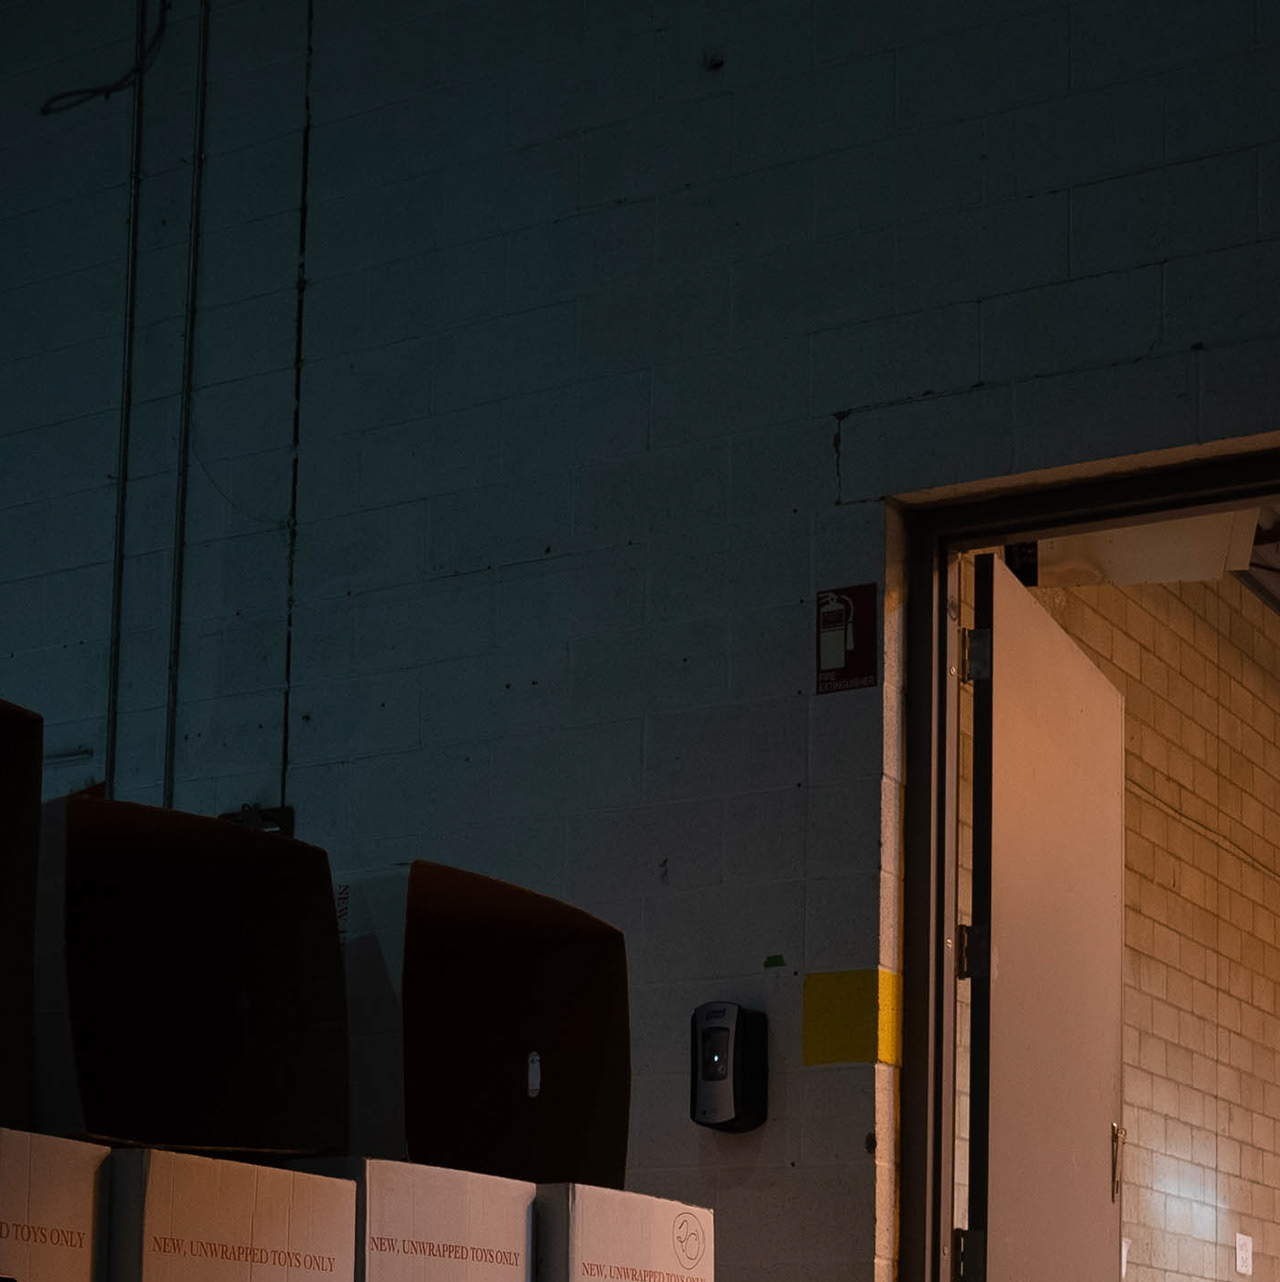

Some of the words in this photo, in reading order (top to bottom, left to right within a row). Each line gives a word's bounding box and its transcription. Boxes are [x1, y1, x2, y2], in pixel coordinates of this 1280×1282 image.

[12, 1224, 47, 1245] TOYS
[50, 1228, 87, 1249] ONLY
[152, 1236, 186, 1257] NEW,
[190, 1241, 269, 1264] UNWRAPPED
[271, 1249, 302, 1268] TOYS
[304, 1253, 336, 1272] ONLY
[370, 1237, 399, 1255] NEW,
[402, 1239, 468, 1260] UNWRAPPED
[470, 1247, 494, 1264] TOYS
[495, 1250, 520, 1267] ONLY
[582, 1262, 607, 1279] NEW,
